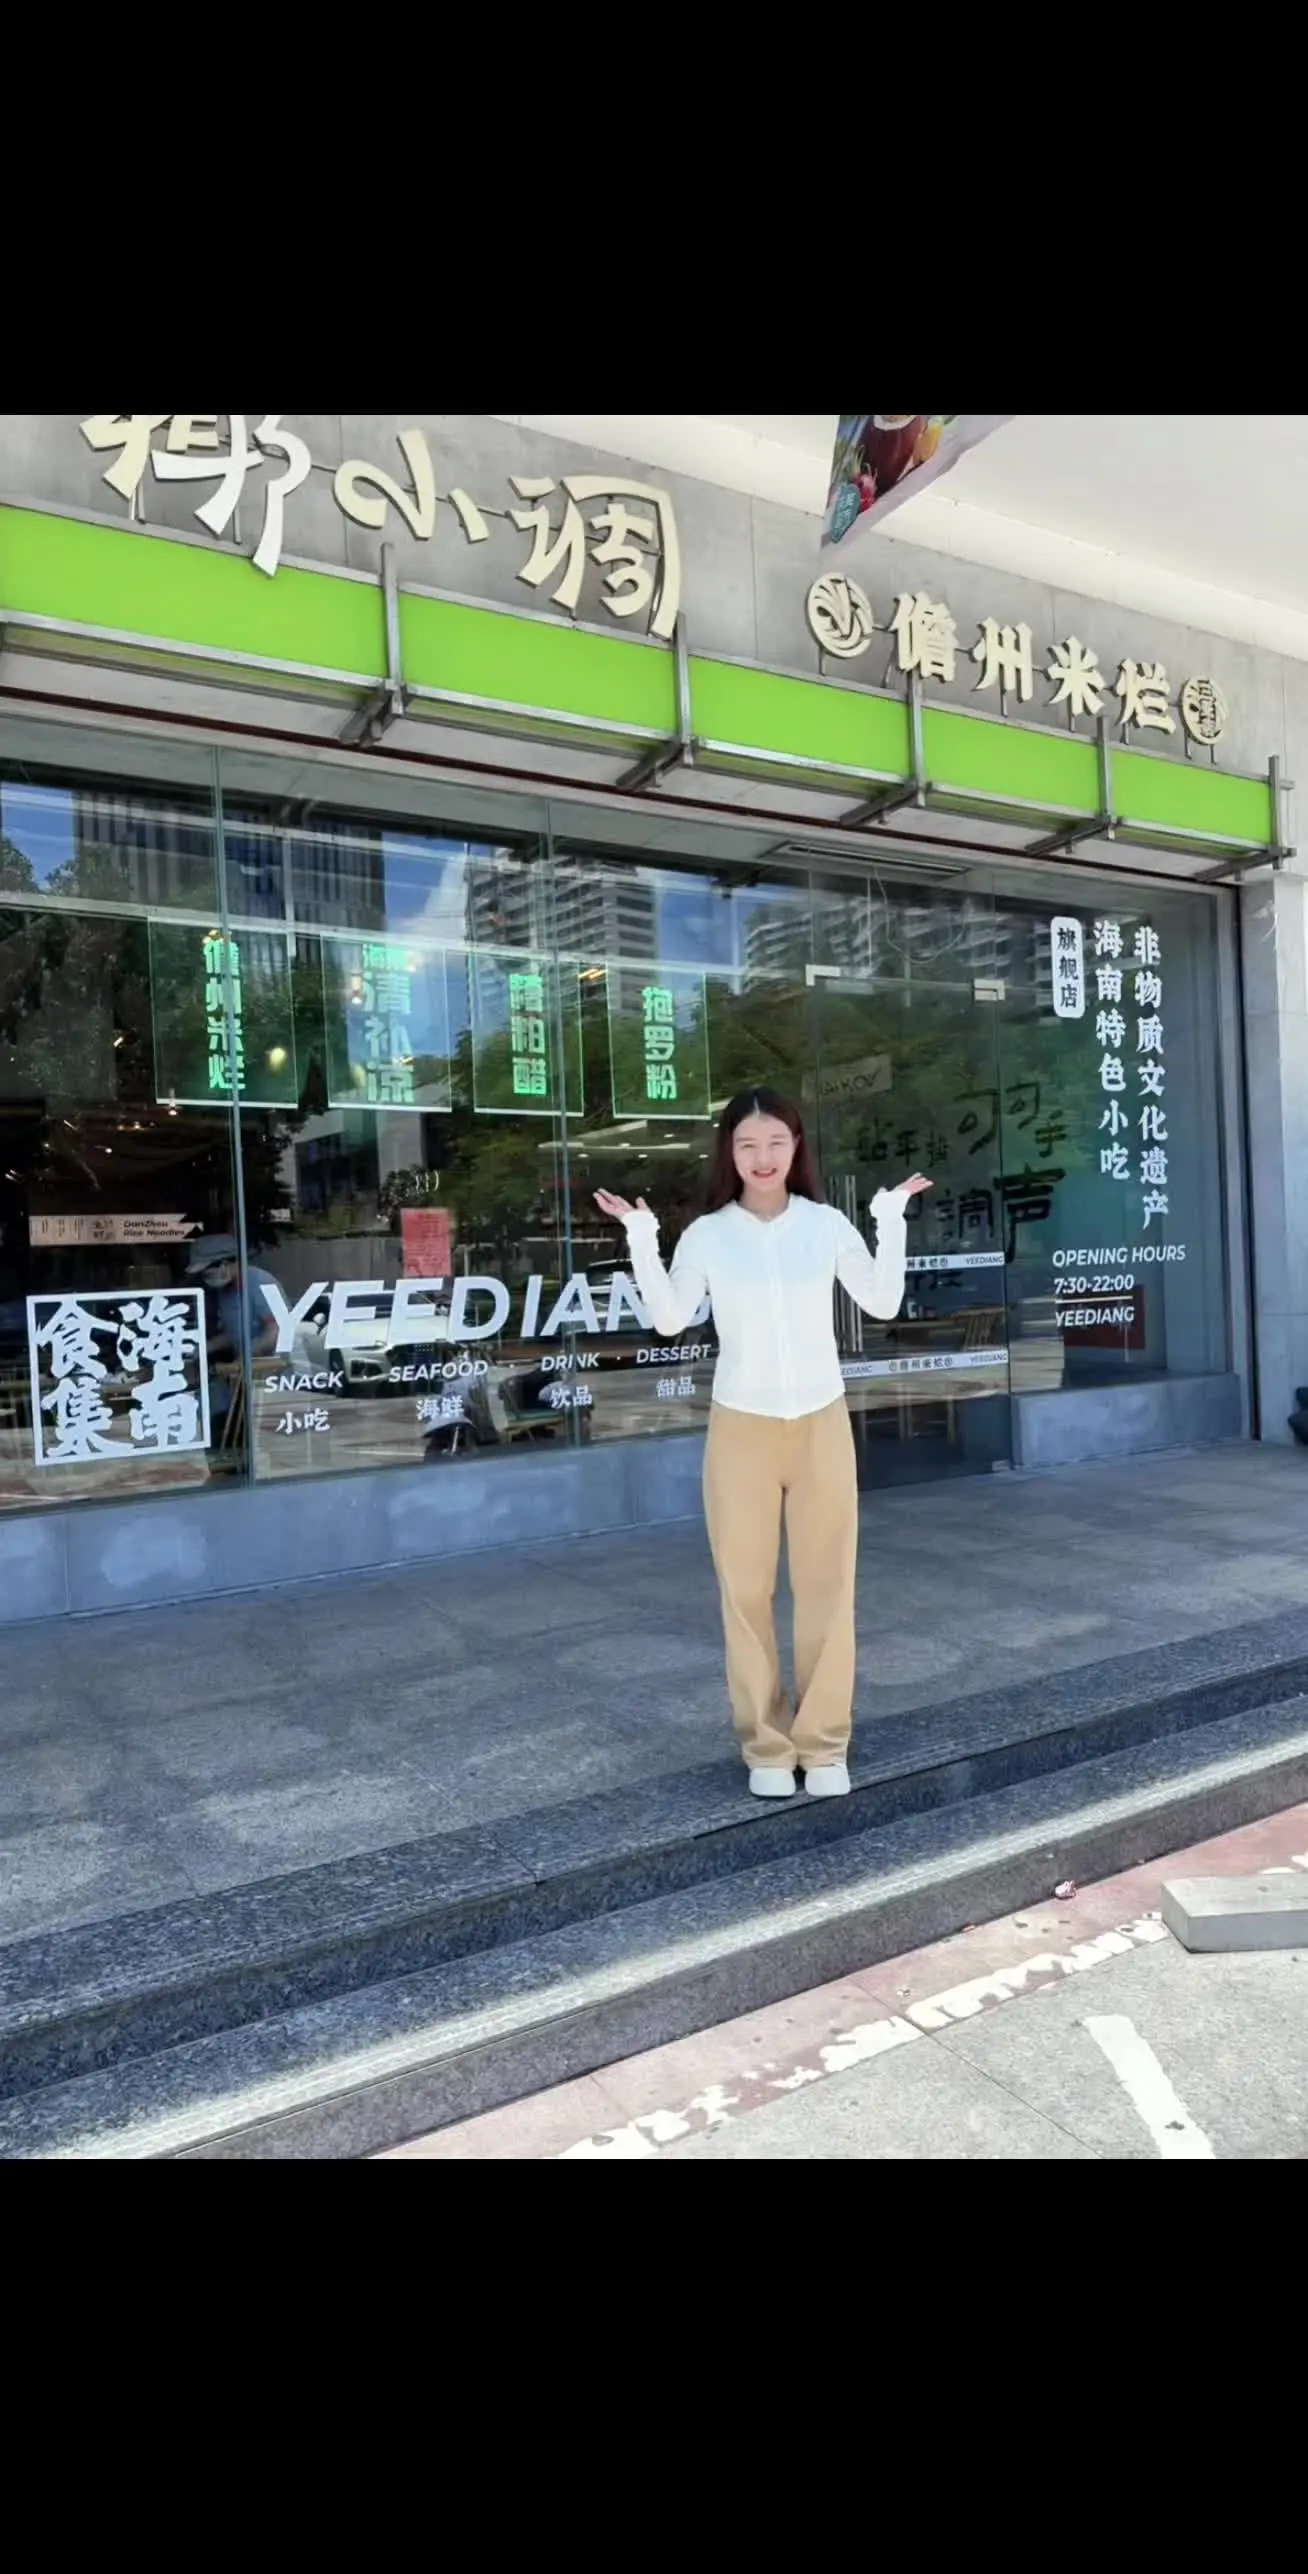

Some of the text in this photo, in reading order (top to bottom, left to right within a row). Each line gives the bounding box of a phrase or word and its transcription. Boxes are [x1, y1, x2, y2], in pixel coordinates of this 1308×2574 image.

[889, 590, 1177, 737] 儋州米烂
[1057, 927, 1079, 1008] 旗舰店
[363, 970, 414, 1103] 清补凉
[642, 986, 677, 1099] 抱罗粉
[1093, 920, 1130, 1181] 海南特色小吃
[1134, 926, 1169, 1230] 非物质文化遗产
[1052, 1244, 1186, 1268] OPENING HOURS
[1054, 1274, 1135, 1295] 7:30-22:00
[260, 1271, 713, 1352] YEEDIAN
[1055, 1305, 1135, 1327] YEEDIANG
[264, 1343, 712, 1394] SNACK SEAFOOD DRINK DESSERT
[275, 1375, 696, 1435] 小吃 海鲜 饮品 甜品
